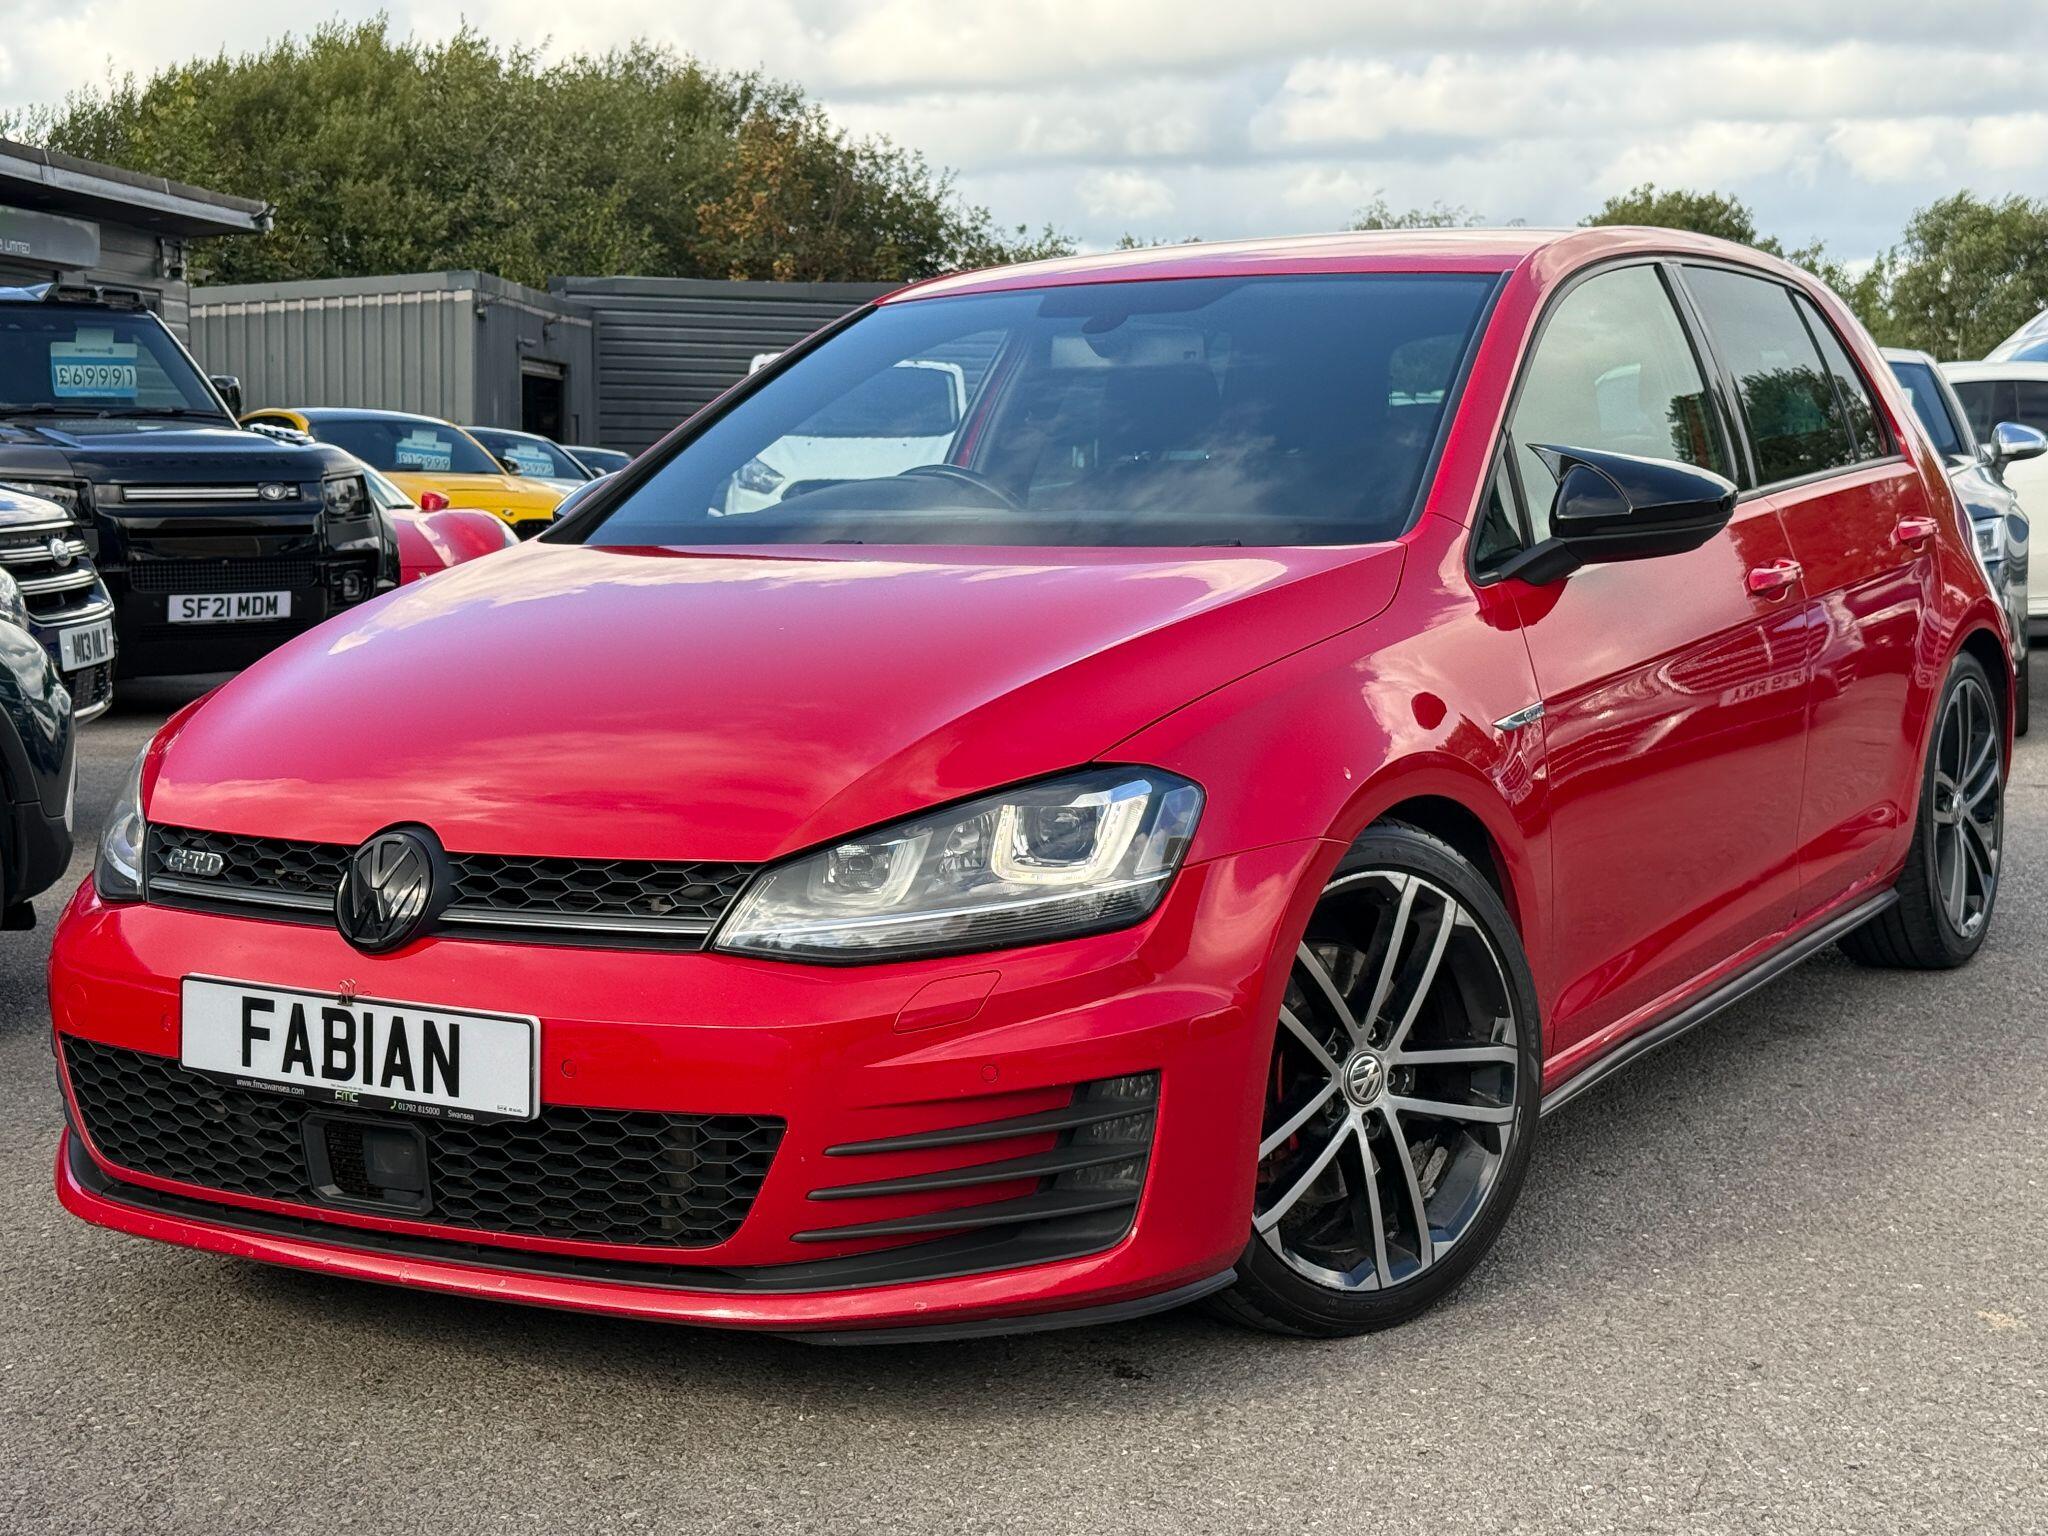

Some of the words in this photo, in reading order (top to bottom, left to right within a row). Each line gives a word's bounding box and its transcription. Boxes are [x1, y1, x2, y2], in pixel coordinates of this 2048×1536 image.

[59, 367, 133, 386] £69991
[182, 597, 231, 618] SF21
[237, 595, 278, 616] MDM
[166, 846, 223, 876] GTD
[242, 996, 460, 1098] FABIAN
[236, 1078, 305, 1096] www.fmcswansea.com
[334, 1090, 359, 1103] FMC
[397, 1102, 417, 1113] 01792
[418, 1105, 440, 1116] 815000
[447, 1109, 475, 1121] Swansea
